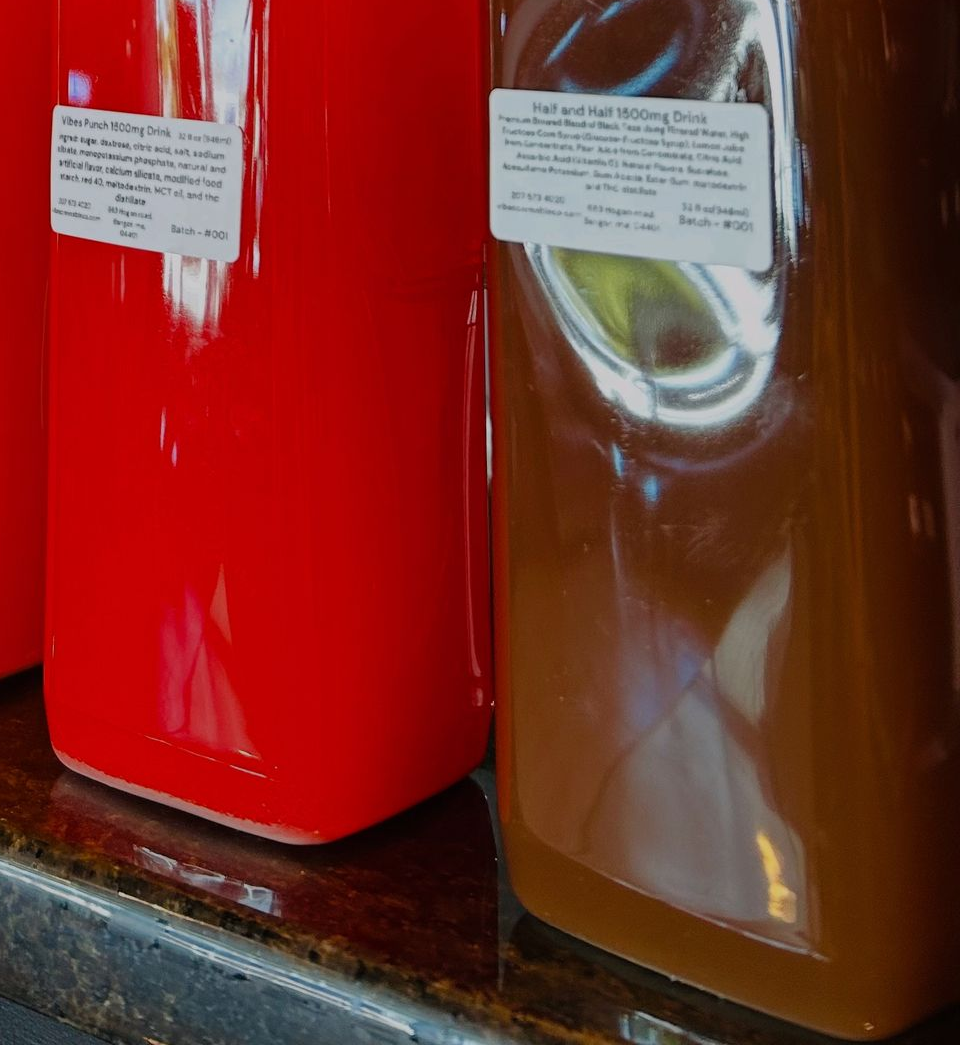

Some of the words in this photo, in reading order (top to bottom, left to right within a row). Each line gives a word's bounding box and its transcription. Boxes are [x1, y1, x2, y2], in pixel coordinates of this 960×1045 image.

[532, 102, 558, 115] Half
[562, 105, 585, 116] and
[589, 106, 613, 117] Half
[673, 111, 707, 124] Drink
[62, 116, 83, 127] Vibes
[84, 118, 109, 130] Punch
[147, 126, 171, 138] Drink
[194, 150, 225, 160] sodium
[178, 162, 208, 172] natural
[210, 166, 226, 174] and
[155, 186, 172, 196] MCT
[187, 192, 203, 201] and
[679, 214, 712, 228] Batch
[723, 220, 754, 233] #001
[171, 224, 196, 236] Batch
[204, 228, 228, 240] #001
